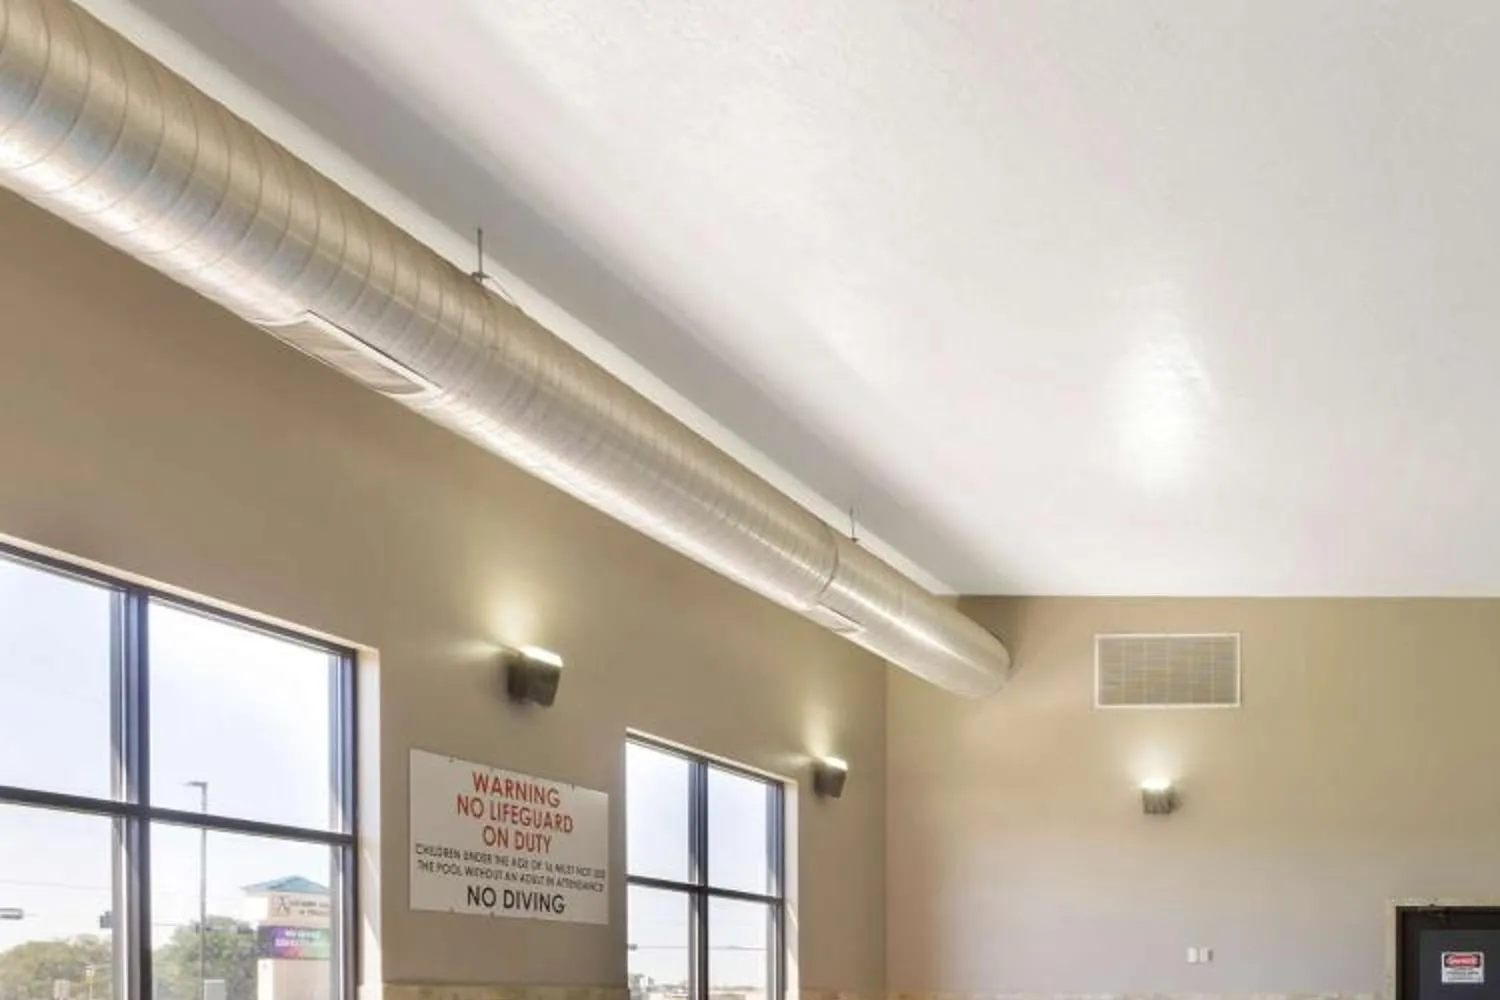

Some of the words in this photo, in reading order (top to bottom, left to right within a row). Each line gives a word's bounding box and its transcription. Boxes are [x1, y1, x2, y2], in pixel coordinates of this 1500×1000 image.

[473, 772, 560, 808] WARNING
[456, 793, 485, 818] NO
[490, 802, 574, 834] LIFEGUARD
[415, 843, 461, 859] CHILDREN
[463, 849, 492, 865] UNDER
[494, 853, 510, 867] THE
[482, 825, 509, 849] ON
[515, 831, 553, 854] DUTY
[417, 859, 435, 873] THE
[436, 861, 462, 877] POOL
[464, 865, 503, 881] WITHOUT
[504, 871, 518, 882] AN
[557, 876, 605, 893] ATTENDANCE
[466, 885, 497, 908] NO
[503, 889, 566, 915] DIVING
